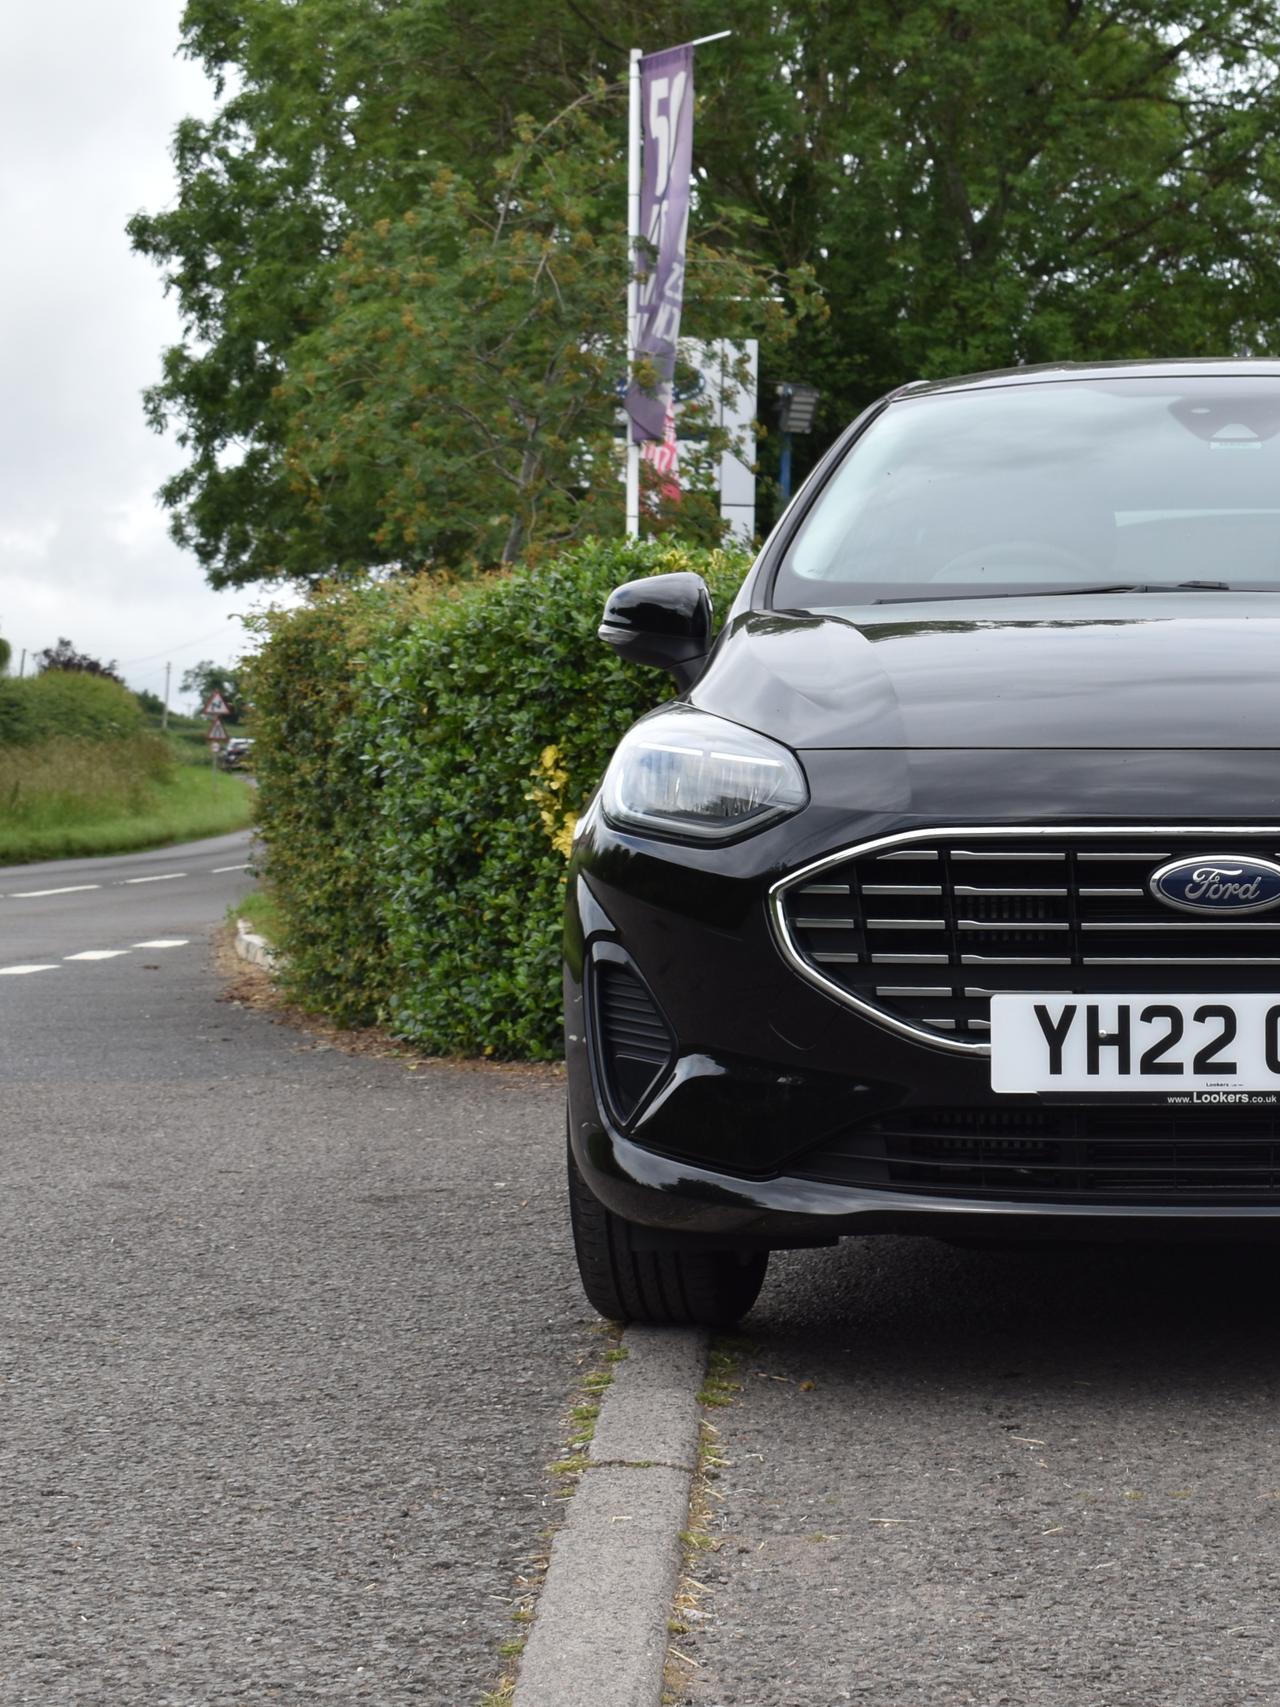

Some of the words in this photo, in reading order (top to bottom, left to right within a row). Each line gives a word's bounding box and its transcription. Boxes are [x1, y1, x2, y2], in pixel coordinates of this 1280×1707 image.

[1184, 867, 1262, 900] Ford
[1033, 1004, 1238, 1076] YH22
[1167, 1091, 1277, 1104] www.Lookers.co.uk
